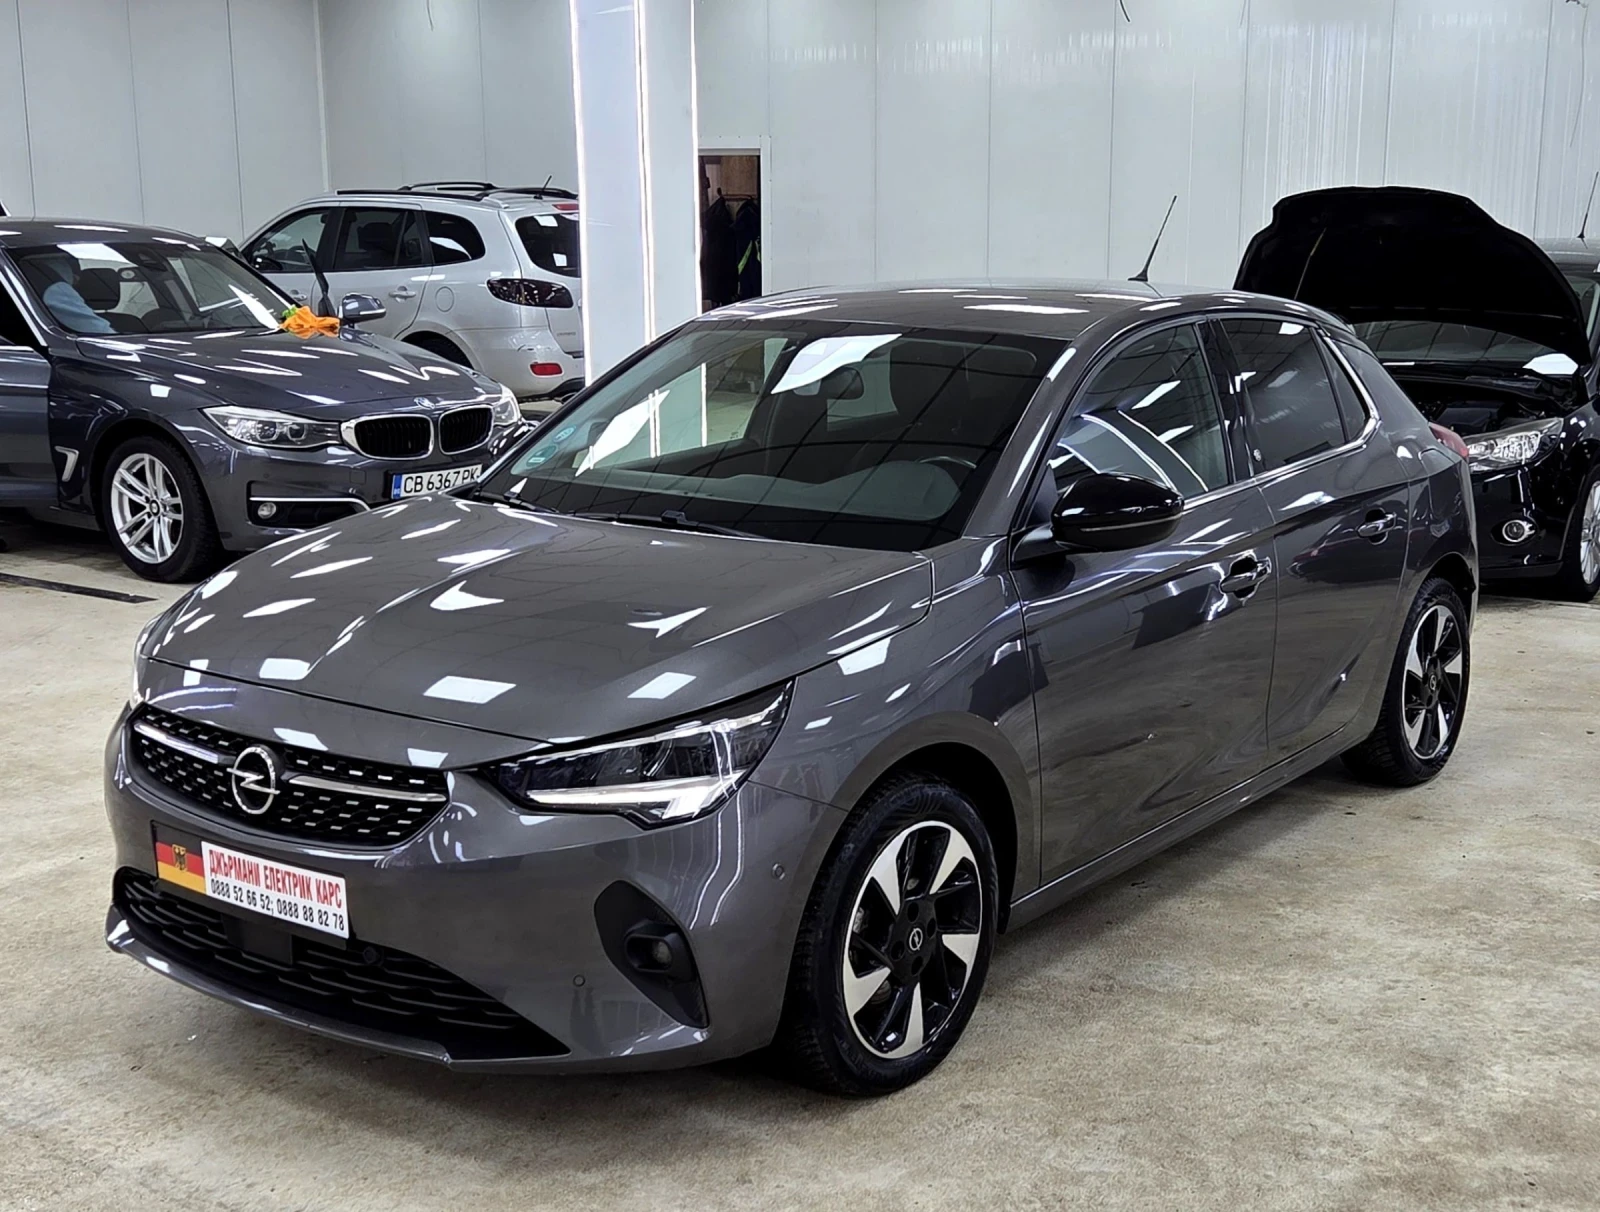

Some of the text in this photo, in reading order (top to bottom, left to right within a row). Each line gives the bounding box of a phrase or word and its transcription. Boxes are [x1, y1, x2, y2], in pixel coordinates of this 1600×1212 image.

[404, 476, 423, 494] CB
[426, 470, 461, 491] 6367
[209, 849, 342, 909] ДЖЪРМАНИ ЕЛЕКТРИК КАРС
[211, 878, 231, 899] 0888
[233, 885, 244, 903] 52
[246, 889, 257, 907] 66
[276, 898, 299, 919] 0888
[302, 905, 314, 923] 88
[317, 909, 330, 927] 82
[332, 913, 345, 931] 78
